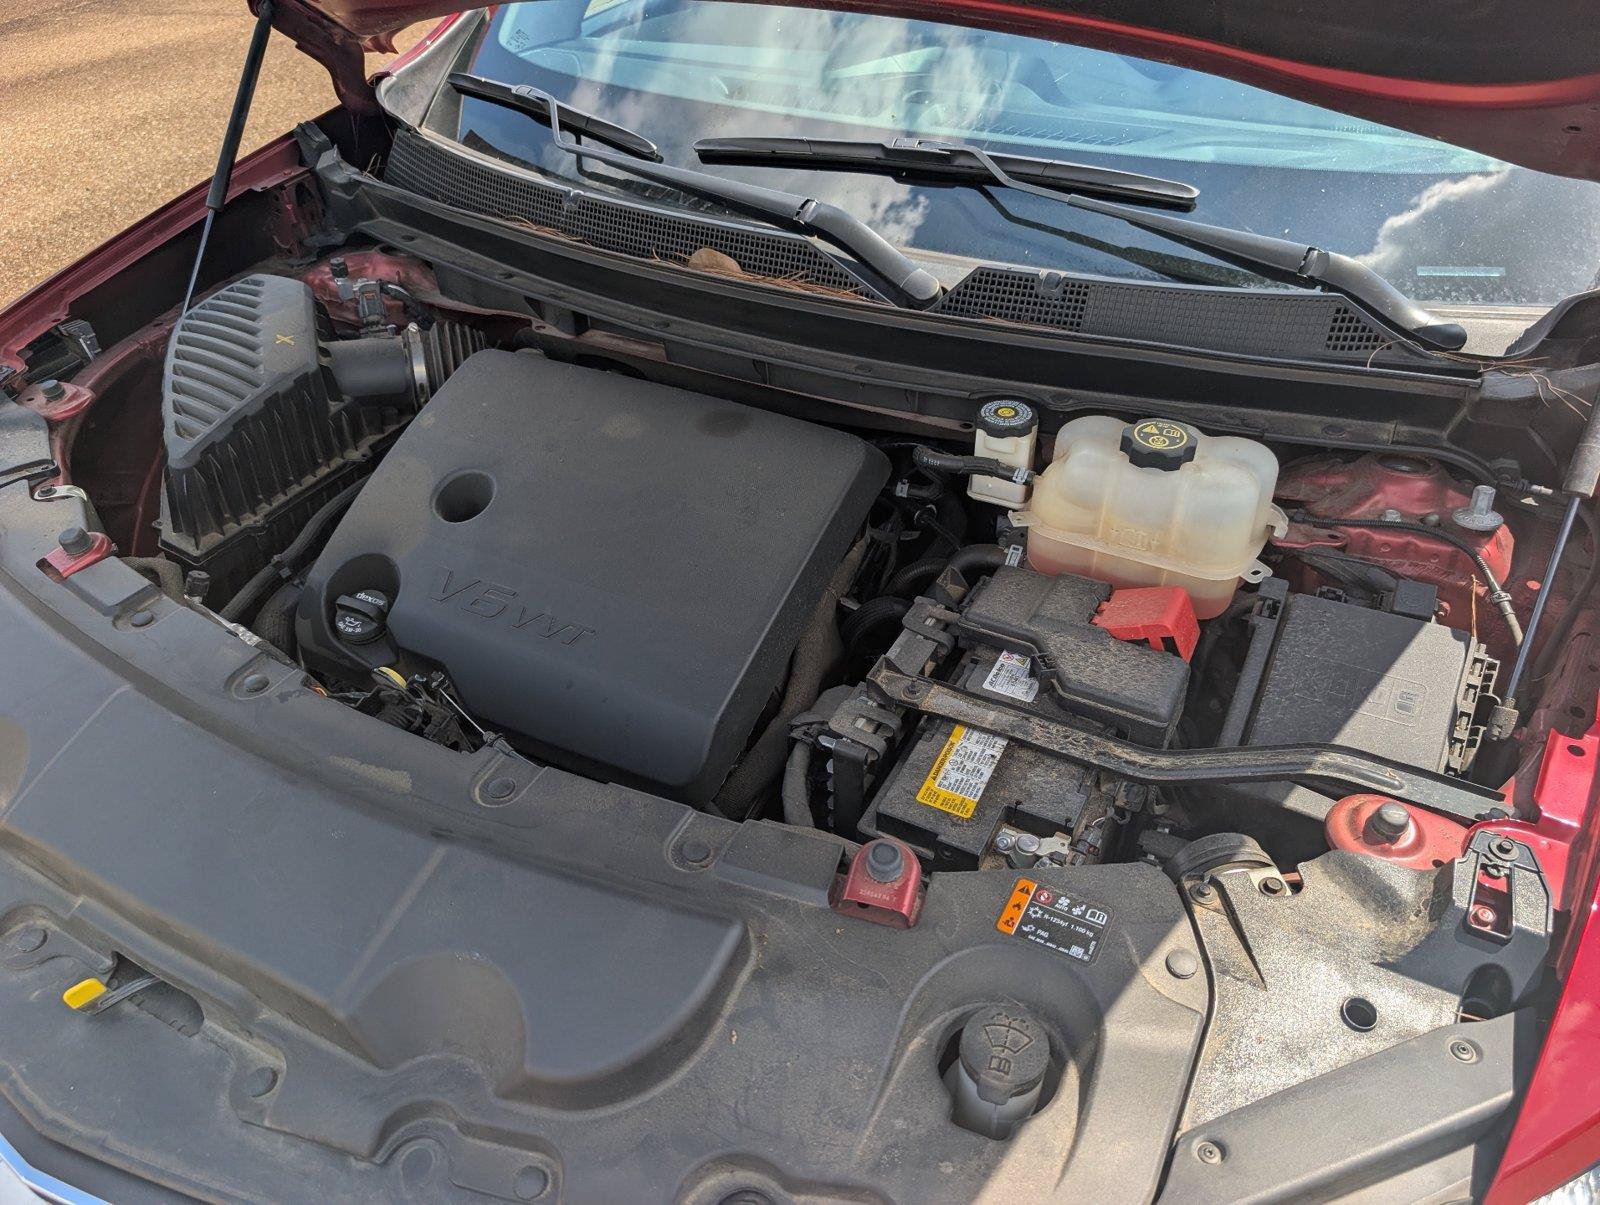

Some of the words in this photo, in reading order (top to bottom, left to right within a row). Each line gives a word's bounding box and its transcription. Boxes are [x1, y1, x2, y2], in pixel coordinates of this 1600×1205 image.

[356, 592, 385, 606] dexos
[431, 567, 518, 619] V6
[511, 606, 598, 646] VVT
[989, 663, 1005, 687] ACDelco
[1036, 929, 1049, 938] PAG
